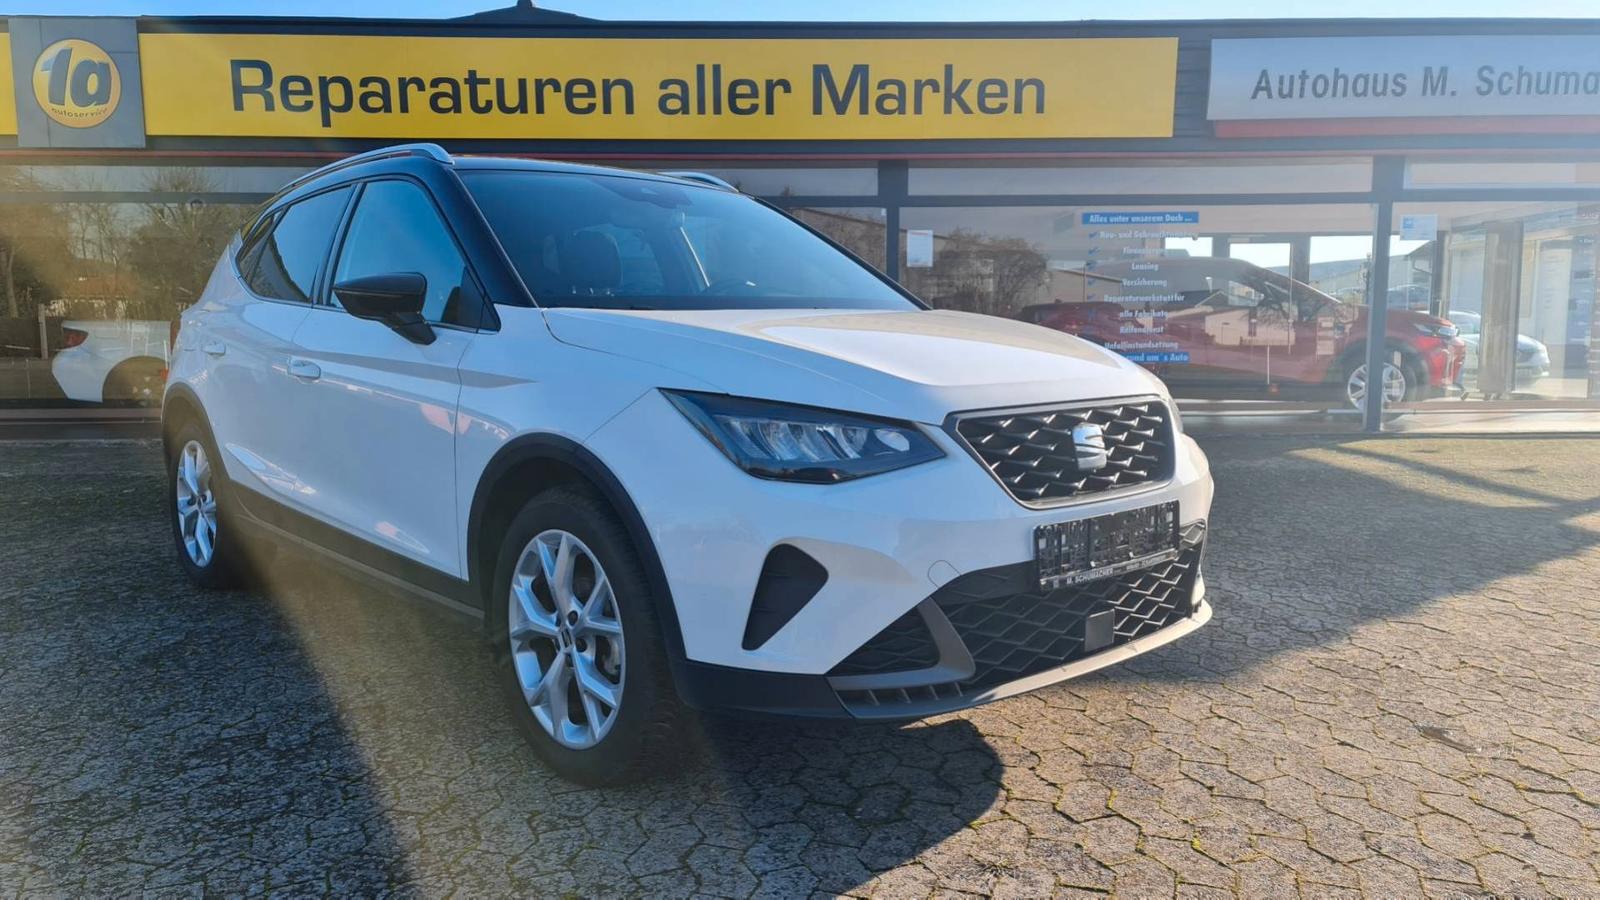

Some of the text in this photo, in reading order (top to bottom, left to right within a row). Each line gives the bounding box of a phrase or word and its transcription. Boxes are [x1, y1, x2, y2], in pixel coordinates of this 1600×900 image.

[41, 48, 112, 107] 1a
[1250, 67, 1408, 99] Autohaus
[1421, 66, 1457, 97] M.
[231, 59, 1047, 128] Reparaturen aller Marken
[1089, 214, 1108, 223] Alles
[1110, 214, 1130, 223] unter
[1131, 214, 1163, 222] unserem
[1165, 214, 1183, 222] Dach
[1131, 262, 1160, 272] Leasing
[1121, 278, 1168, 288] Versicherung
[1170, 352, 1189, 361] Auto
